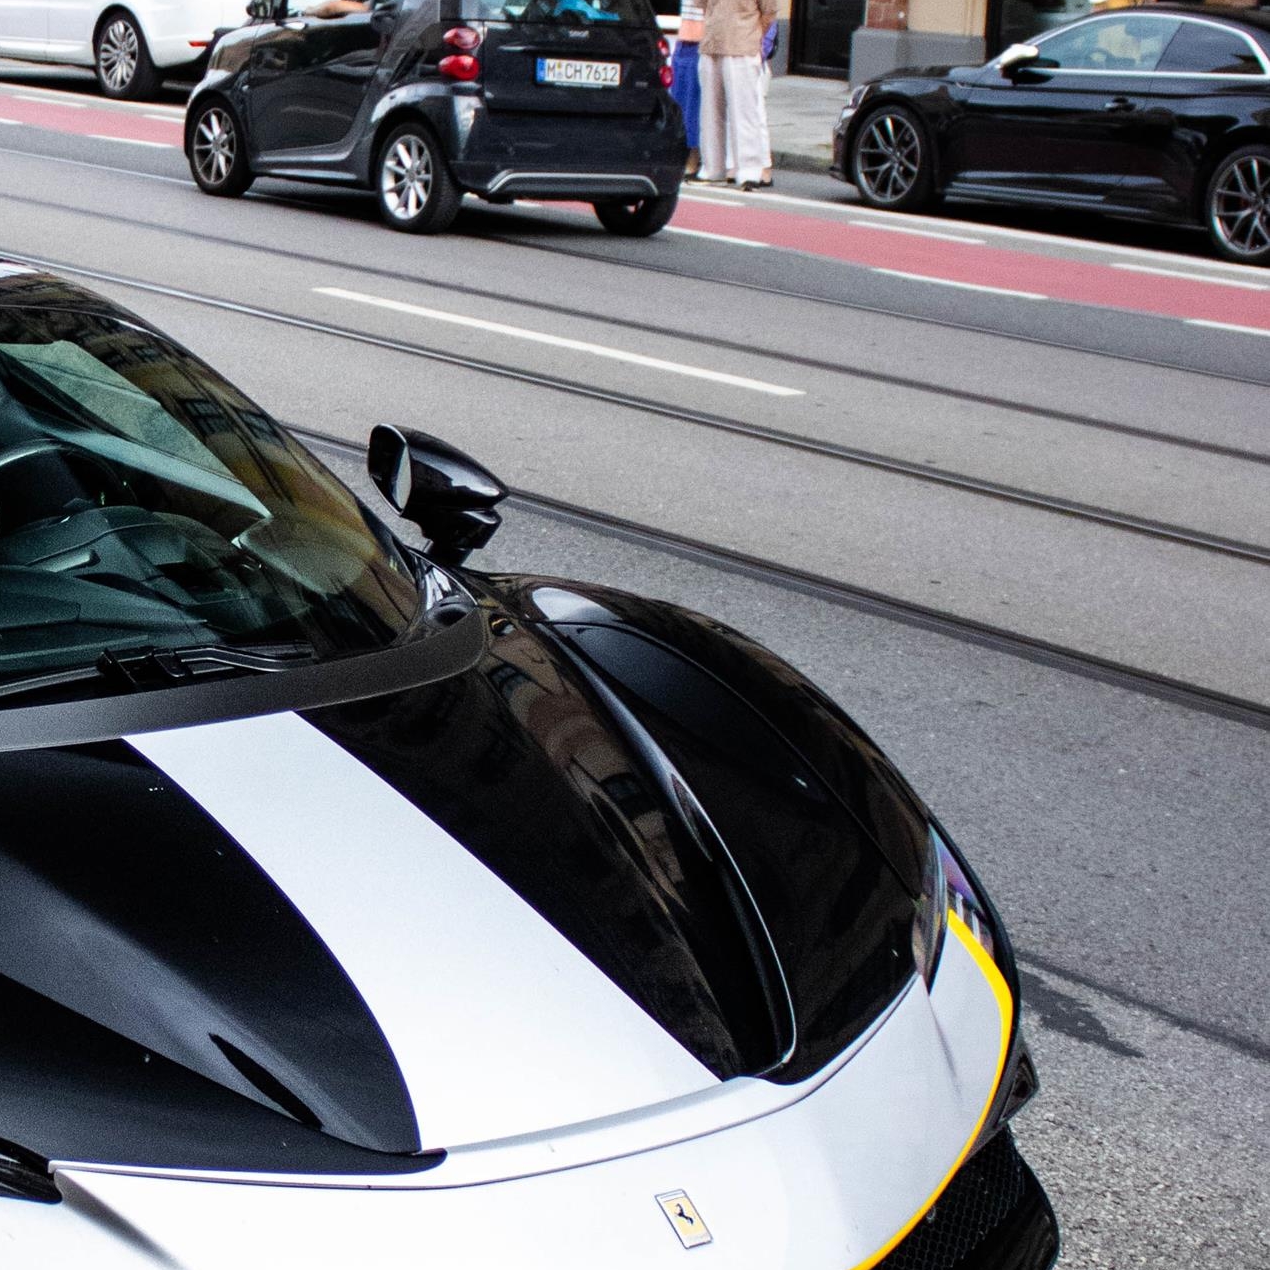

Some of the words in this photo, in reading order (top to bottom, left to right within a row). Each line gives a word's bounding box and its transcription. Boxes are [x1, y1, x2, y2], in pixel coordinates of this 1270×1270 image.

[547, 62, 556, 78] M
[564, 64, 583, 80] CH
[586, 66, 618, 83] 7612
